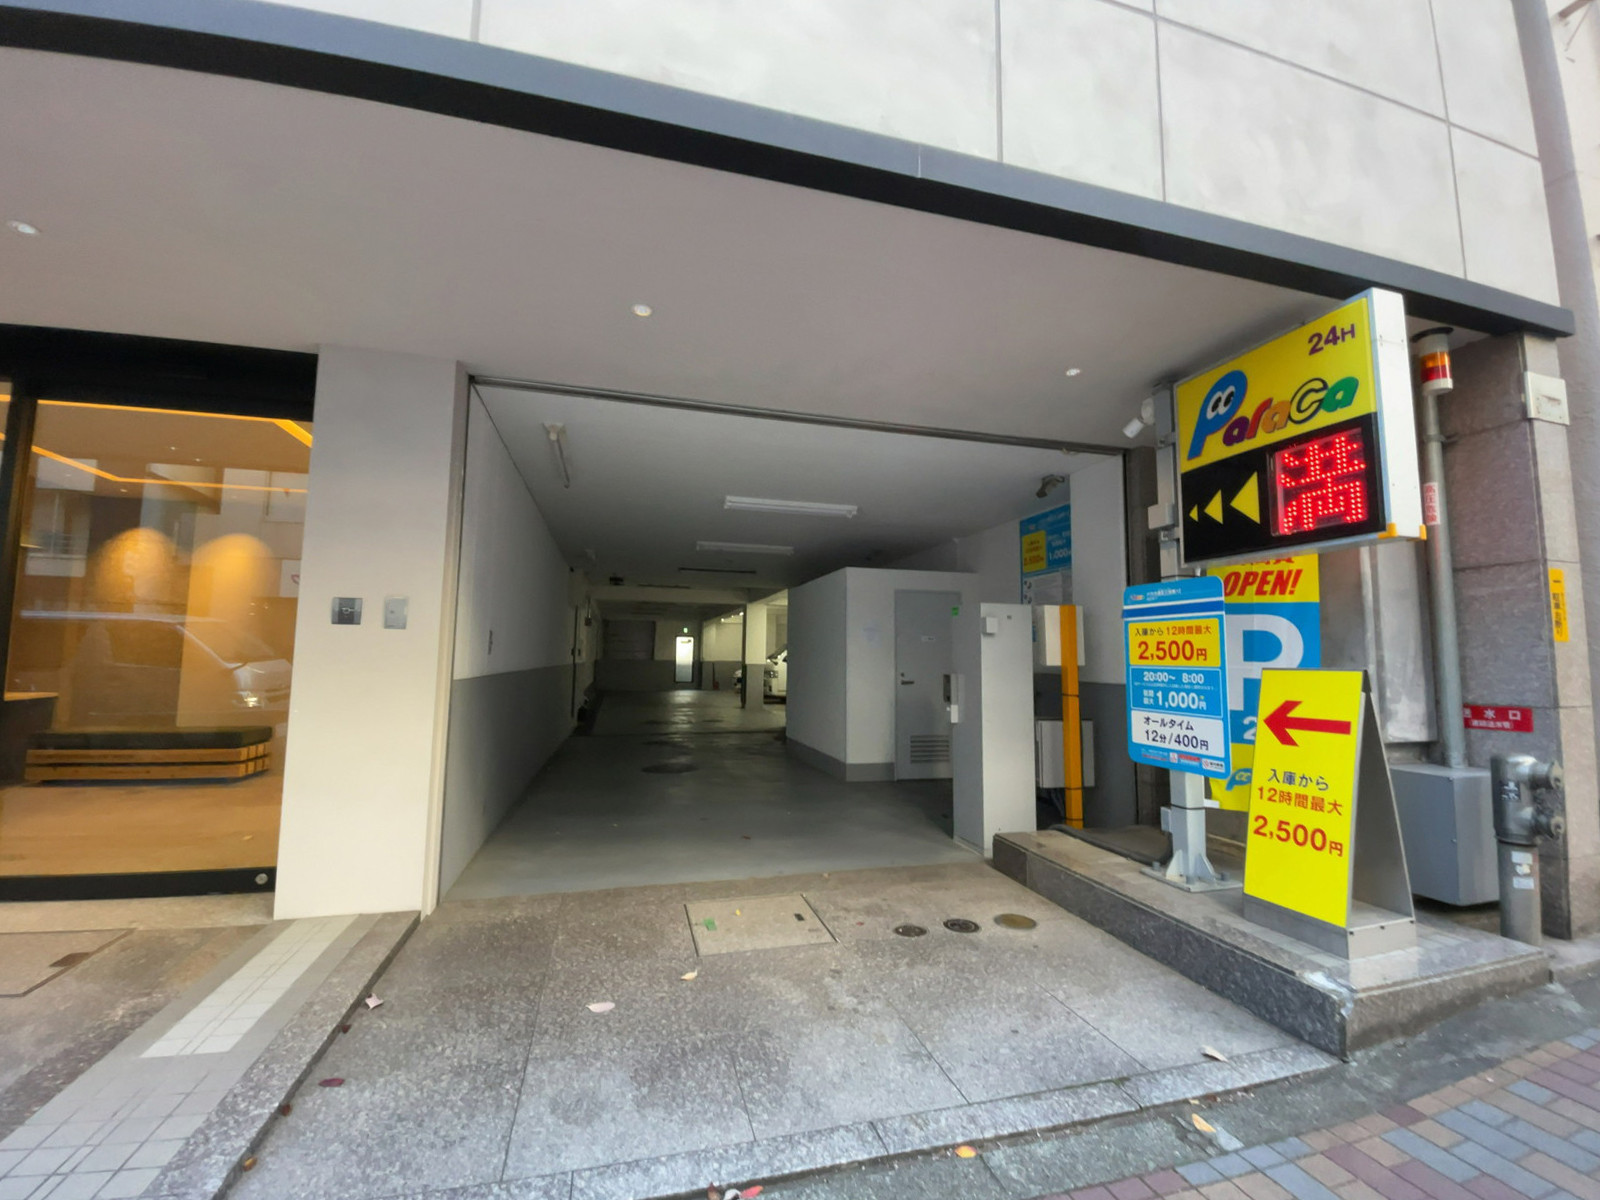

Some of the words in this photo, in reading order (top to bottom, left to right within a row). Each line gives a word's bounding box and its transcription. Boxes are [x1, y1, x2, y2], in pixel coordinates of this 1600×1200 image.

[1307, 323, 1357, 357] 24H
[1279, 436, 1367, 534] 満
[1223, 568, 1303, 598] OPEN!
[1135, 626, 1164, 637] 入庫から
[1166, 624, 1212, 636] 12時間最大
[1137, 639, 1208, 662] 2,500円
[1182, 673, 1204, 684] 8:00
[1155, 690, 1207, 711] 1,000円
[1143, 716, 1195, 731] オールタイム
[1267, 767, 1330, 792] 入庫から
[1256, 785, 1344, 817] 12時間最大
[1252, 814, 1344, 858] 2,500円
